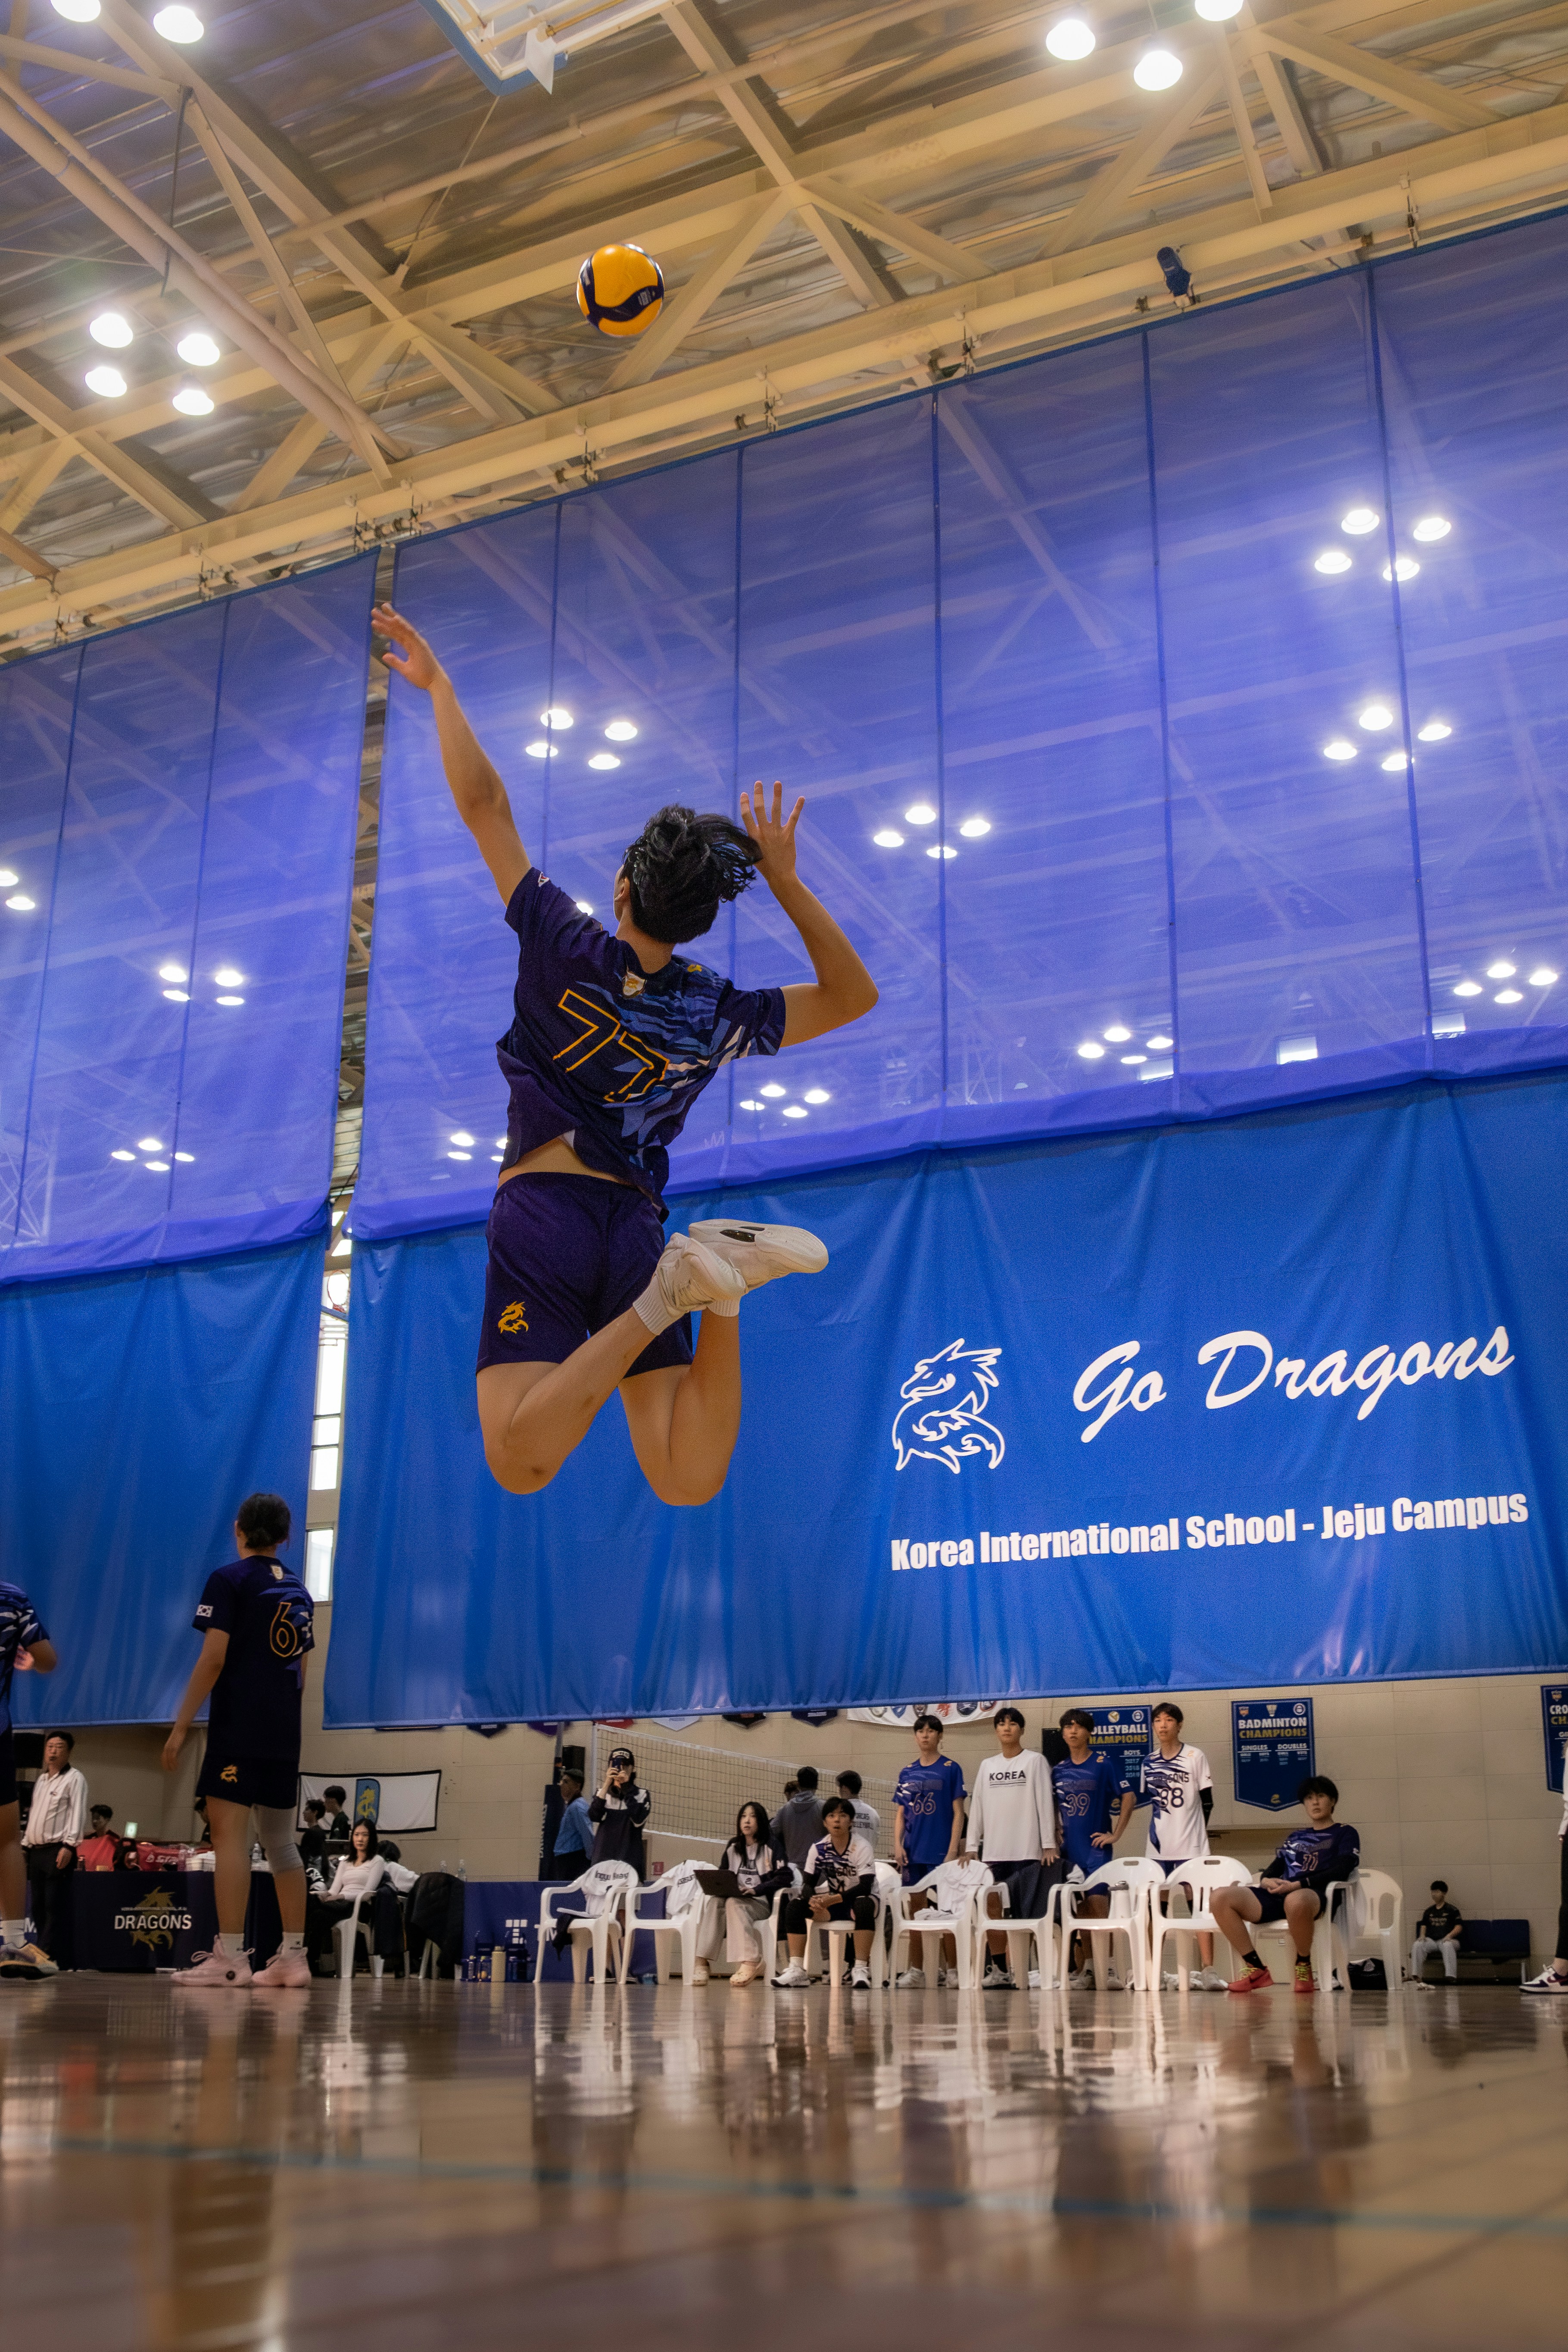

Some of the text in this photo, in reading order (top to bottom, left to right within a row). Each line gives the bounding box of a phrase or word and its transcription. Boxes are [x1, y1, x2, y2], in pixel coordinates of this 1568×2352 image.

[1073, 1326, 1514, 1442] Go Dragons
[892, 1539, 974, 1570] Korea
[981, 1519, 1179, 1563] International
[1186, 1509, 1295, 1548] School
[1321, 1504, 1385, 1540] Jeju
[1392, 1494, 1527, 1532] Campus
[270, 1602, 297, 1657] 6
[1238, 1717, 1307, 1729] BADMINTON
[1551, 1716, 1568, 1725] CH
[1090, 1724, 1148, 1735] OLLEYBALL
[1239, 1728, 1307, 1739] CHAMPIONS
[1088, 1734, 1148, 1744] HAMPIONS
[989, 1770, 1026, 1781] KOREA
[912, 1792, 936, 1815] 66
[1065, 1793, 1091, 1817] 39
[114, 1915, 192, 1930] DRAGONS
